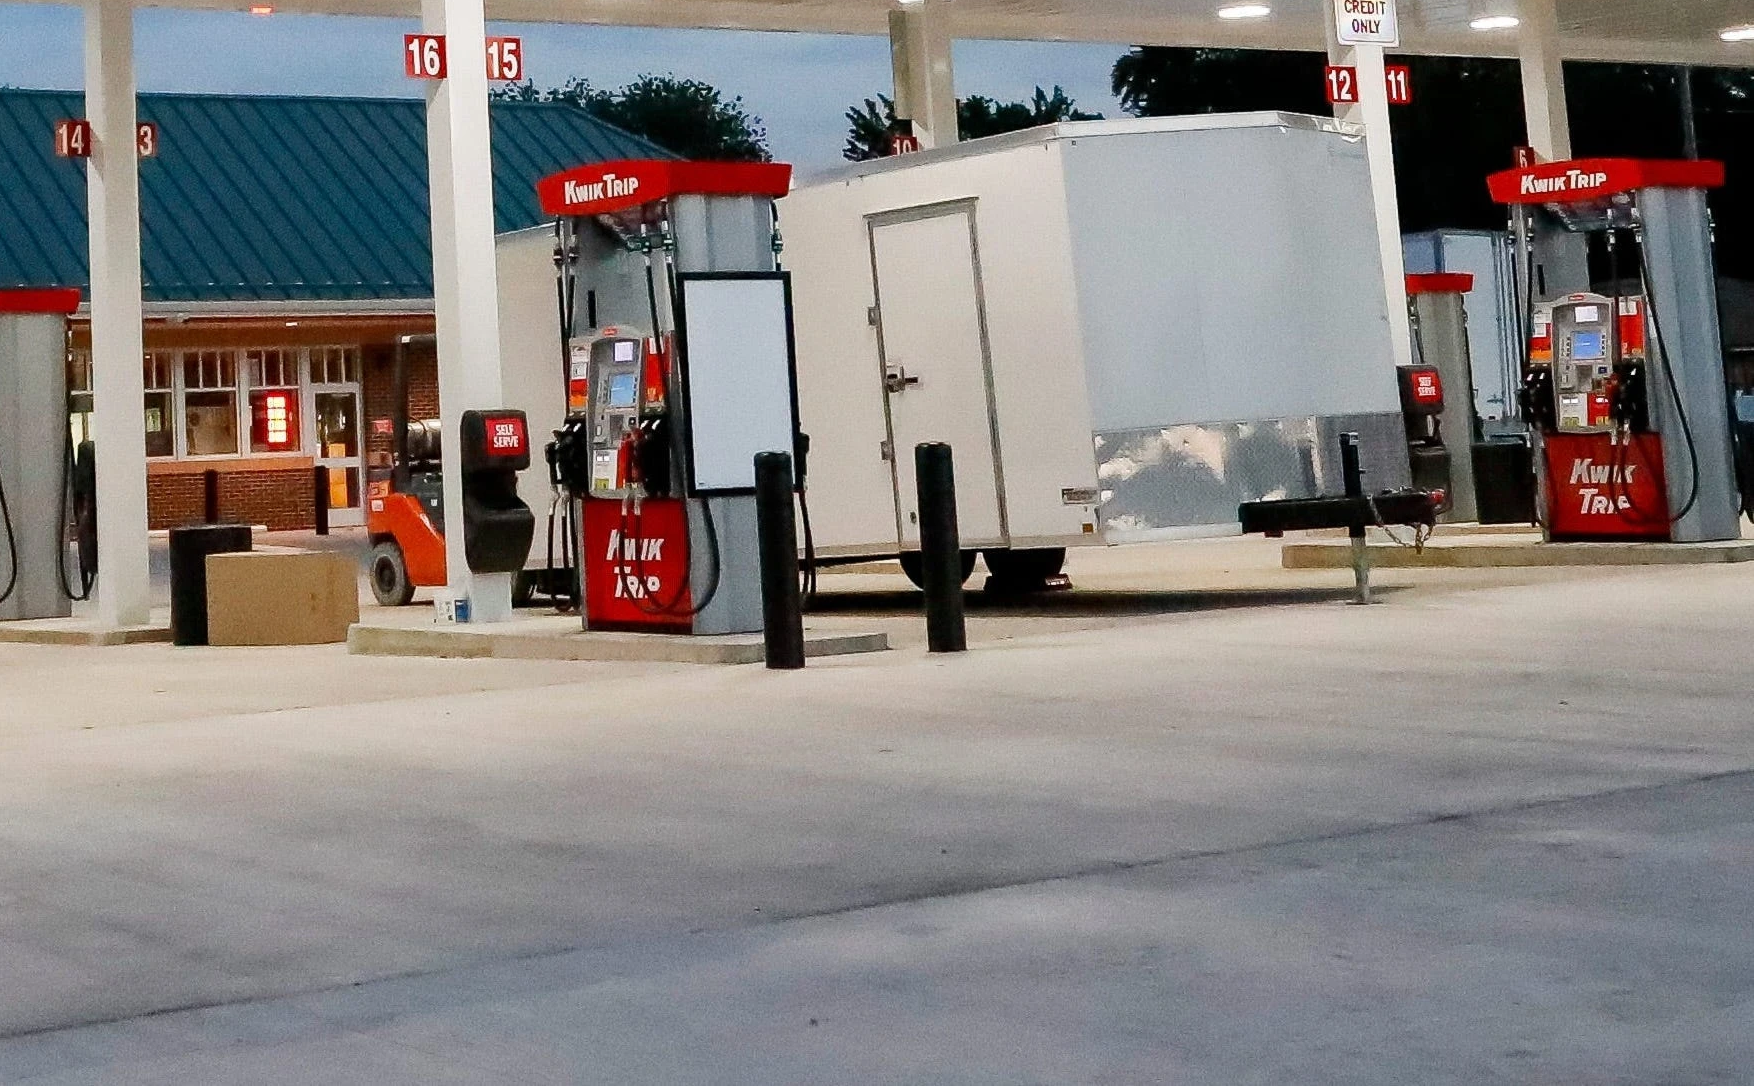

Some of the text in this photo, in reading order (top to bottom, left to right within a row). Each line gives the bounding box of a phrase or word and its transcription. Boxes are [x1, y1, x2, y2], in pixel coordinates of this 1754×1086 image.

[1344, 0, 1386, 15] CREDIT
[1352, 18, 1380, 34] ONLY
[408, 38, 441, 76] 16
[487, 41, 518, 79] 15
[1328, 69, 1353, 101] 12
[1387, 70, 1407, 101] 11
[58, 123, 84, 155] 14
[139, 125, 153, 156] 3
[564, 173, 639, 205] KWIK TRIP
[1520, 169, 1607, 195] KWIK TRIP
[493, 435, 519, 448] SERVE
[495, 424, 514, 436] SELF
